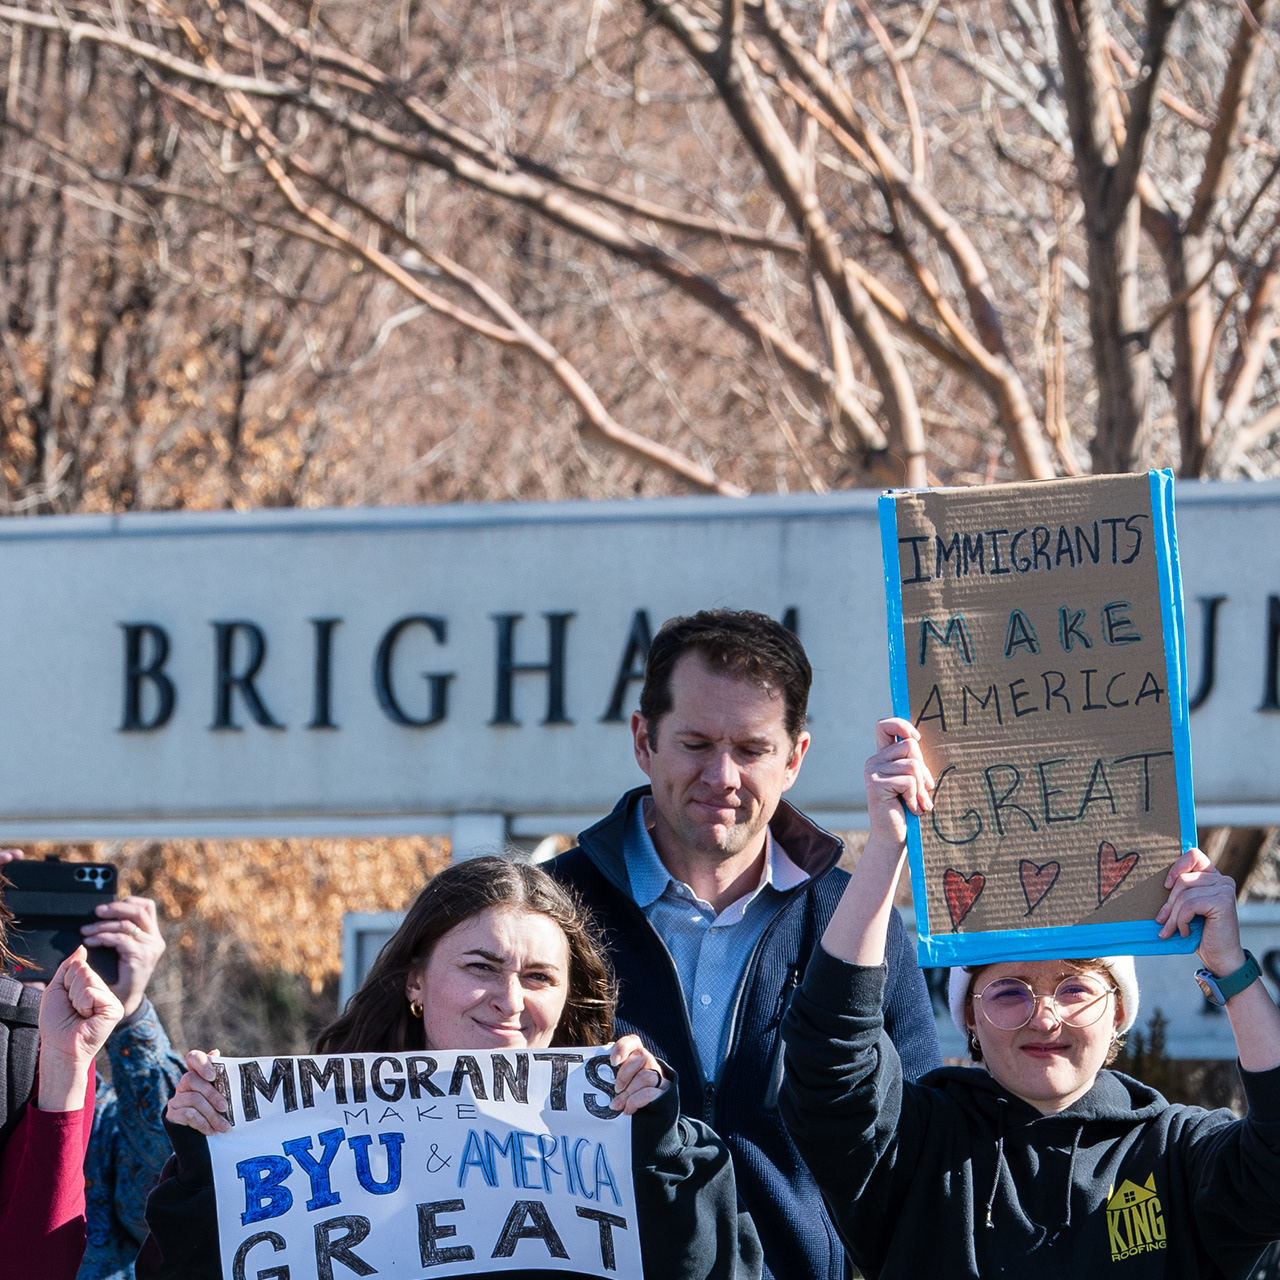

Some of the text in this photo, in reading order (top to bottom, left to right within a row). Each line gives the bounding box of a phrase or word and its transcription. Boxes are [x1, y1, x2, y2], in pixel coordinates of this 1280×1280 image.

[898, 513, 1150, 585] IMMIGRANTS
[919, 600, 1143, 667] MAKE
[114, 604, 812, 733] BRIGHA
[913, 668, 1166, 732] AMERICA
[928, 749, 1175, 846] GREAT
[211, 1052, 621, 1128] IMMIGRANTS
[343, 1103, 478, 1126] MAKE
[235, 1127, 624, 1227] BYU & AMERICA
[1105, 1196, 1168, 1255] KING
[1111, 1240, 1168, 1263] ROOFING
